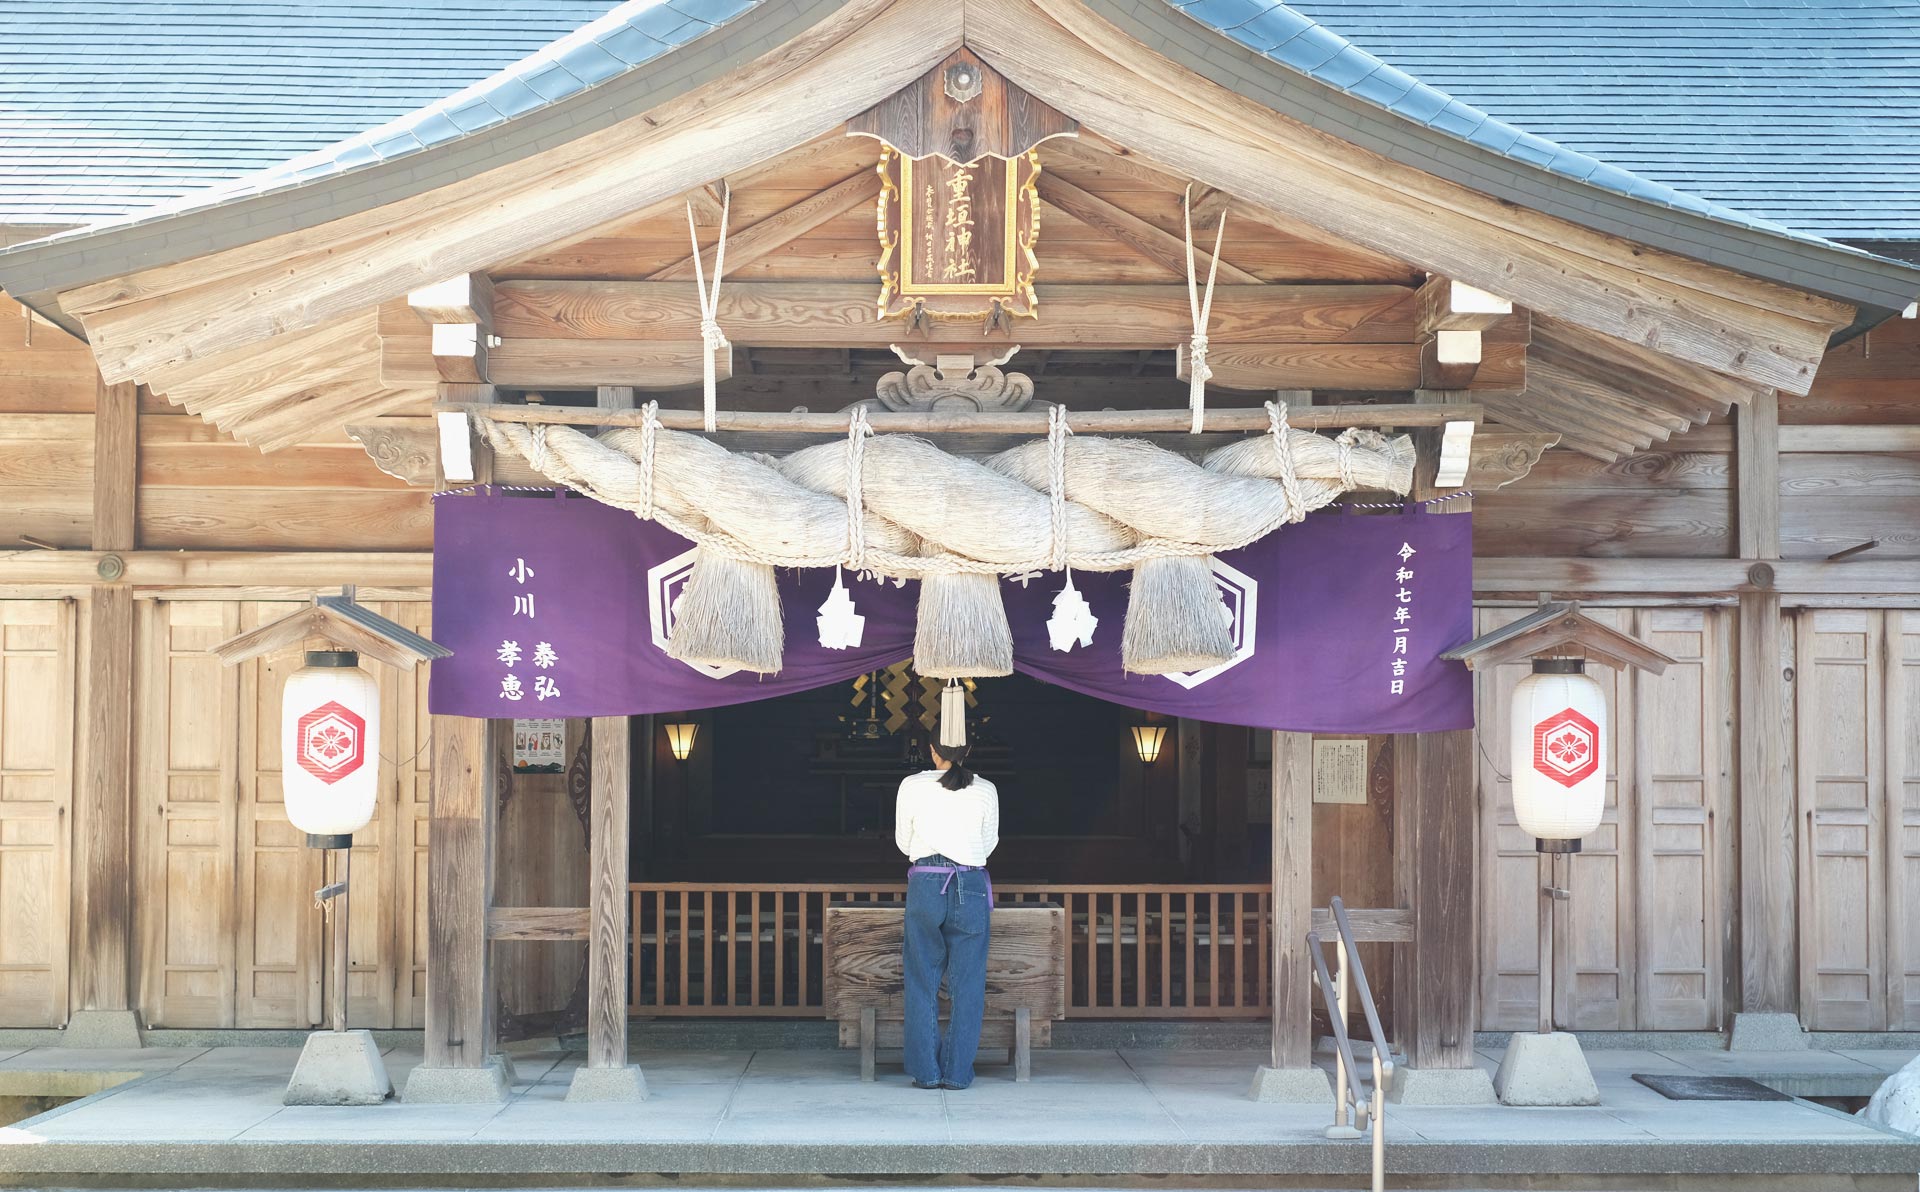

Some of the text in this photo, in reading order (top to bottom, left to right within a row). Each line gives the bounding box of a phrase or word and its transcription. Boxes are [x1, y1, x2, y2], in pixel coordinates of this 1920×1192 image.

[508, 558, 535, 619] 小川
[1390, 542, 1417, 695] 令和七年一月吉日
[496, 639, 525, 701] 孝恵
[532, 641, 561, 702] 泰弘
